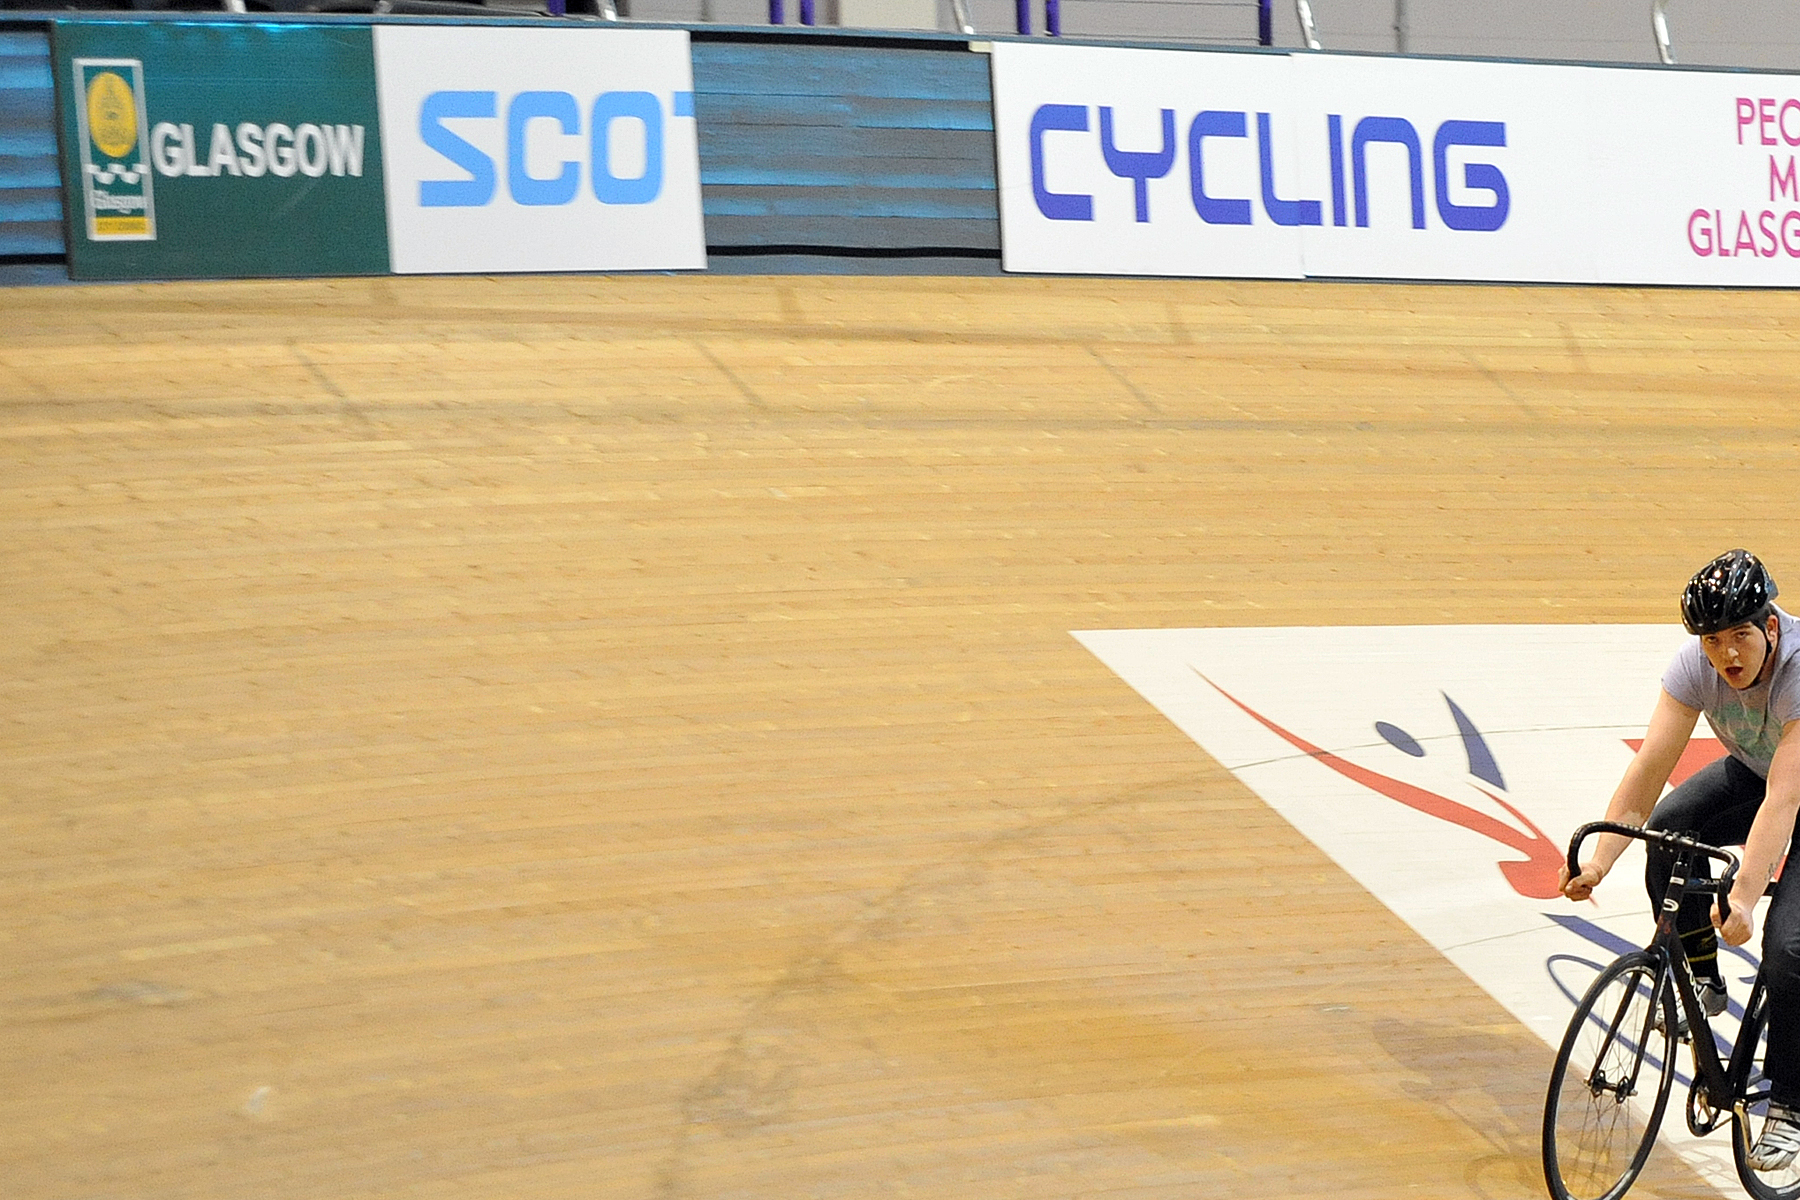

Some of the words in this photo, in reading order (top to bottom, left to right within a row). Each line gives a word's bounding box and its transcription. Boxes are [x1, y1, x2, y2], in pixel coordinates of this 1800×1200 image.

[151, 122, 365, 177] GLASGOW
[418, 90, 696, 207] SCO
[1030, 103, 1510, 232] CYCLING
